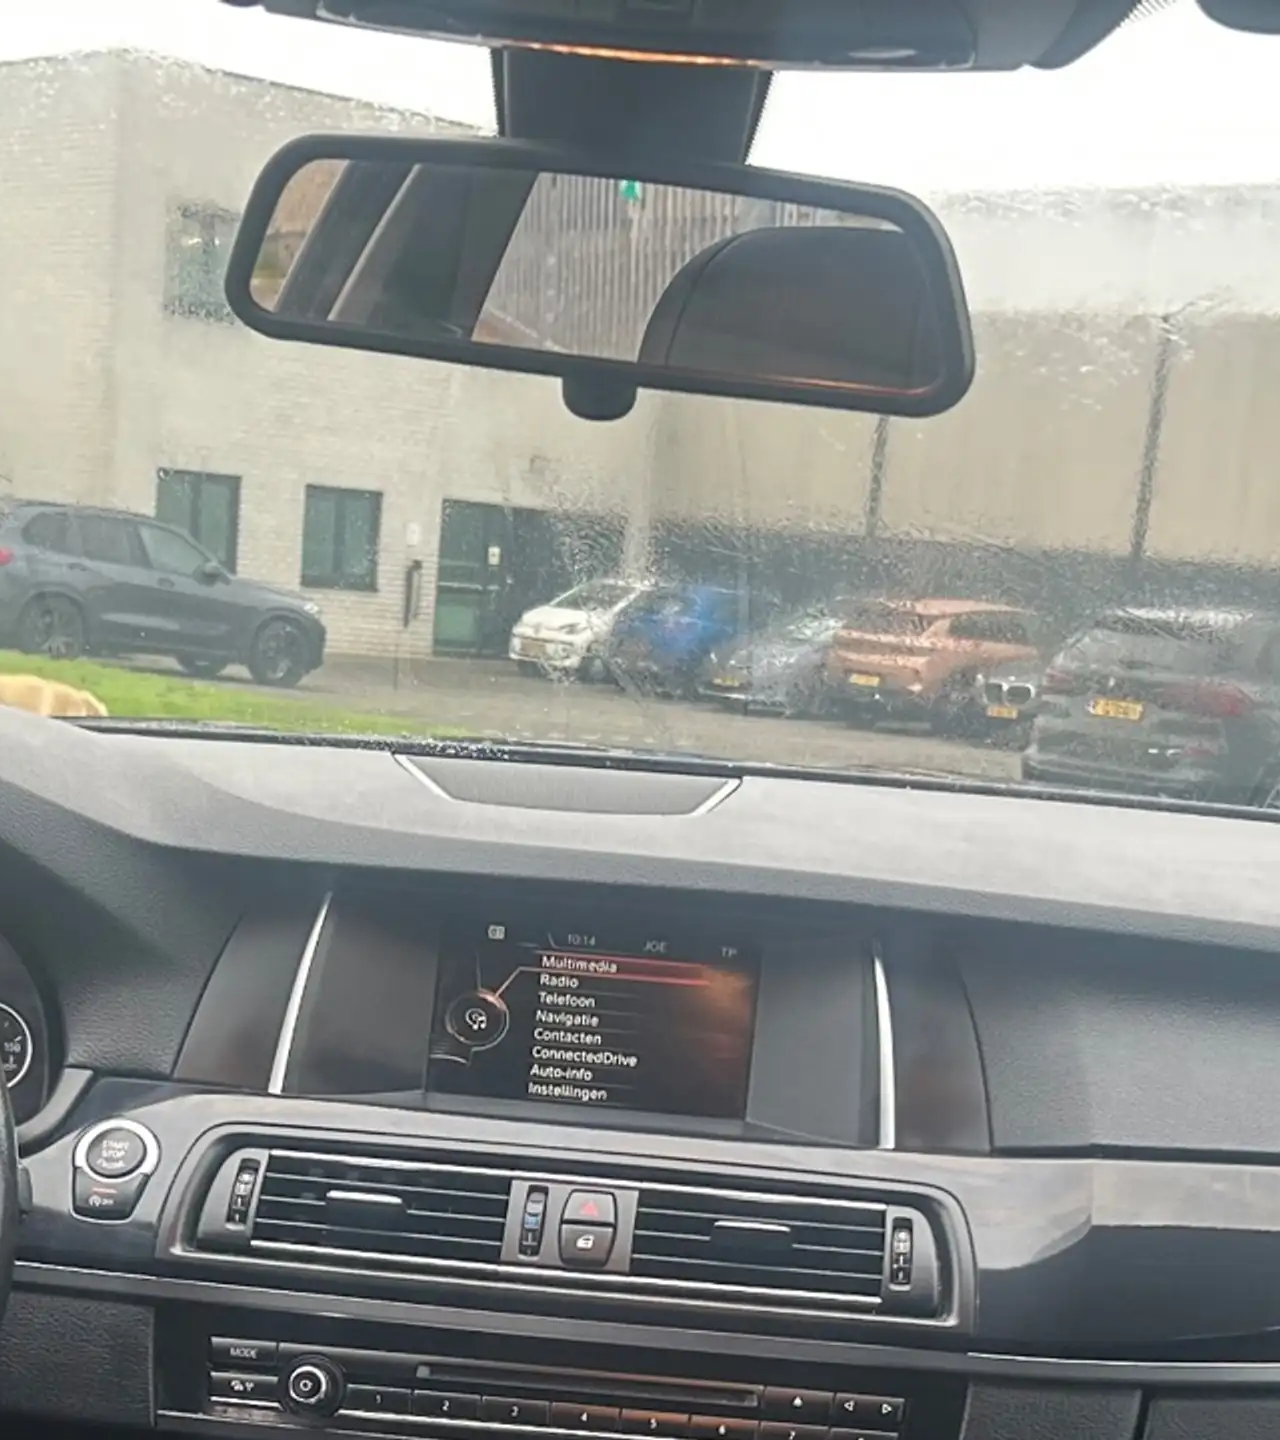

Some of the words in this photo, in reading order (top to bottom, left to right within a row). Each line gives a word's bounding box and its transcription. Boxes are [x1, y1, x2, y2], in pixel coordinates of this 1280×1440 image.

[567, 933, 596, 947] 10:14
[541, 954, 618, 975] Multimedia
[539, 973, 579, 989] Radio
[538, 991, 596, 1008] Telefoon
[535, 1009, 600, 1028] Navigatie
[533, 1027, 602, 1046] Contacten
[531, 1045, 639, 1068] ConnectedDrive
[529, 1064, 593, 1082] Auto-info
[527, 1081, 608, 1102] Instellingen
[101, 1149, 125, 1159] STOP
[229, 1347, 259, 1359] MODE
